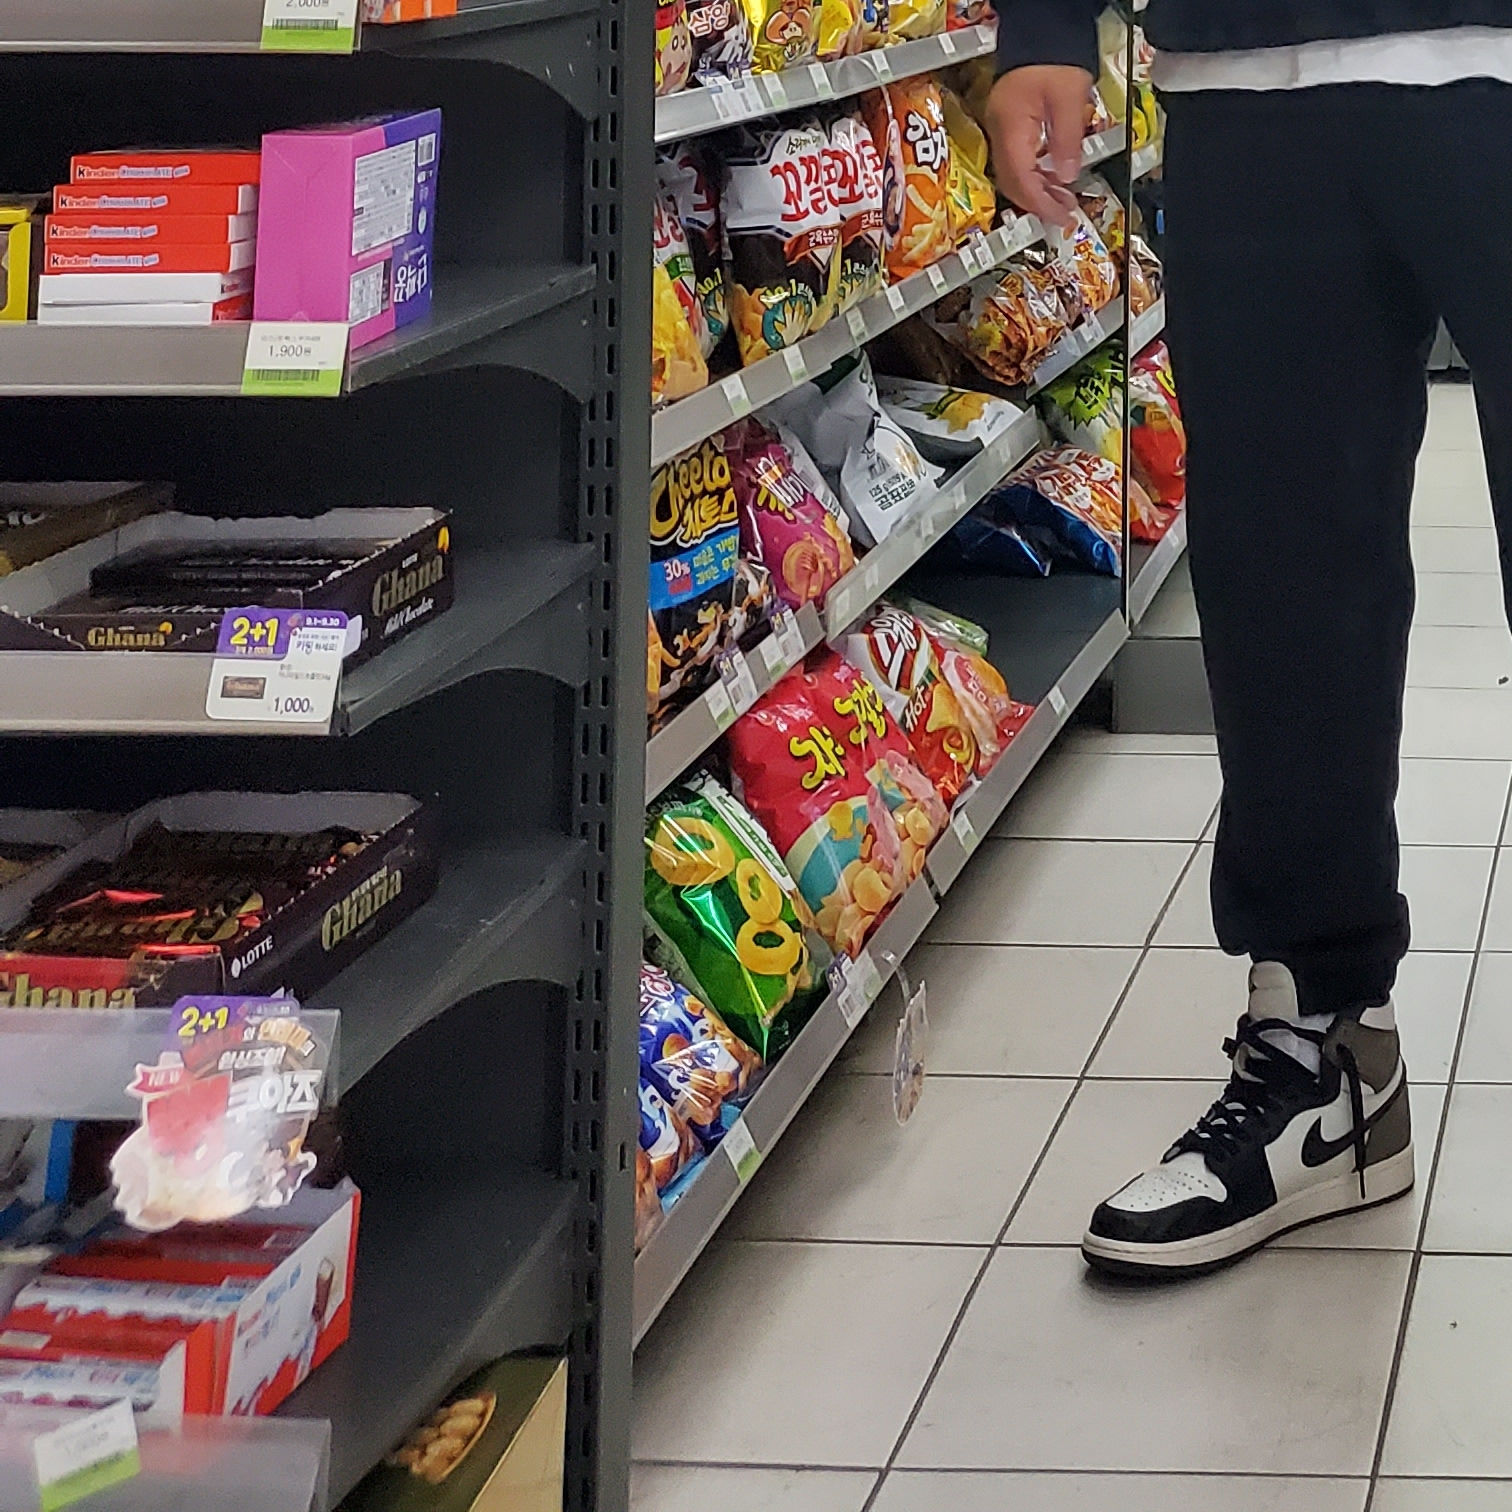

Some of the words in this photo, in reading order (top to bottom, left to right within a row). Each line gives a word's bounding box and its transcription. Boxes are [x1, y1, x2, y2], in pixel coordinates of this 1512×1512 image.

[650, 438, 731, 539] Cheeto
[372, 555, 444, 616] Ghana
[87, 627, 165, 647] Ghana
[229, 617, 279, 646] 2+1
[321, 868, 402, 952] Ghana
[241, 936, 274, 970] LOTTE
[0, 973, 135, 1009] hana
[179, 1007, 229, 1037] 2+1
